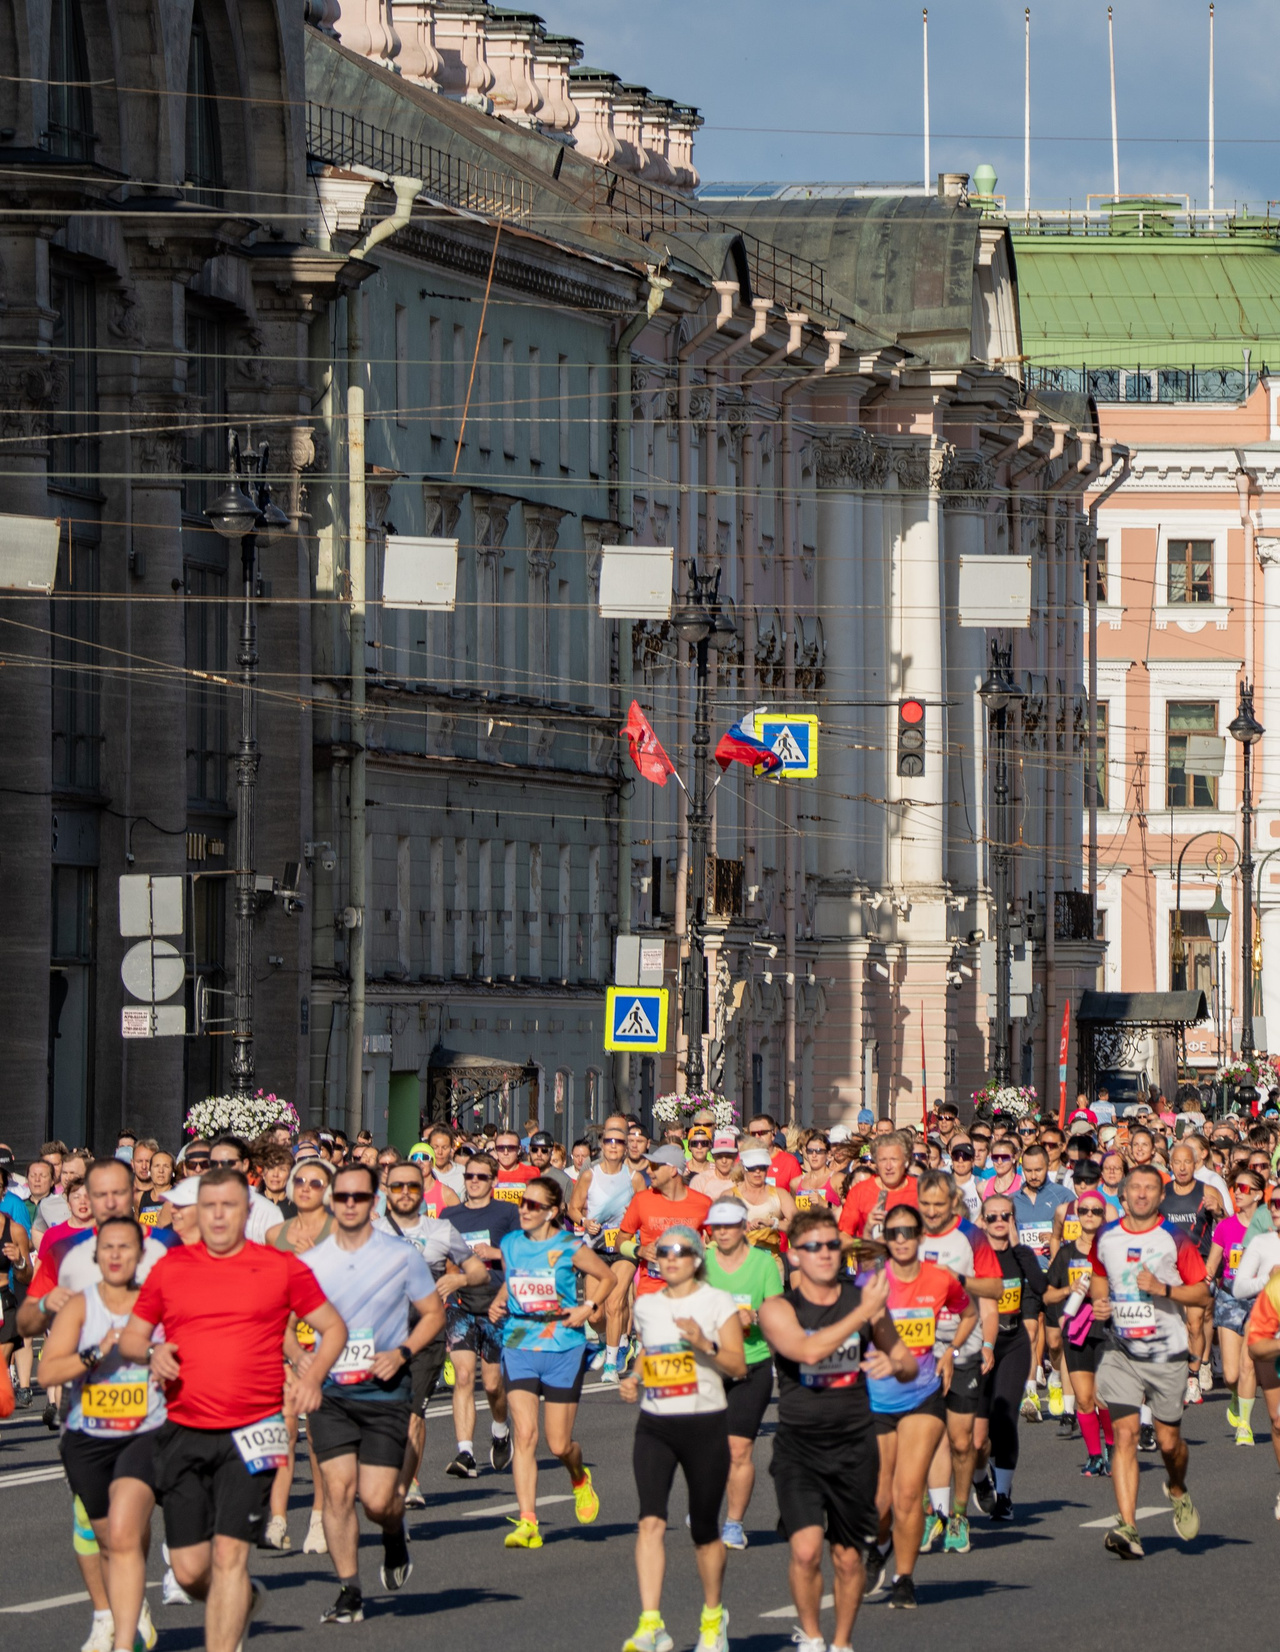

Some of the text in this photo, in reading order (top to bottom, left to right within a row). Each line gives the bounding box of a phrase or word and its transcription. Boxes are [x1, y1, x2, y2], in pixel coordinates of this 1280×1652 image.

[512, 1283, 554, 1297] 14988
[1114, 1305, 1152, 1318] 14443
[645, 1355, 694, 1377] 11795
[87, 1388, 144, 1407] 12900
